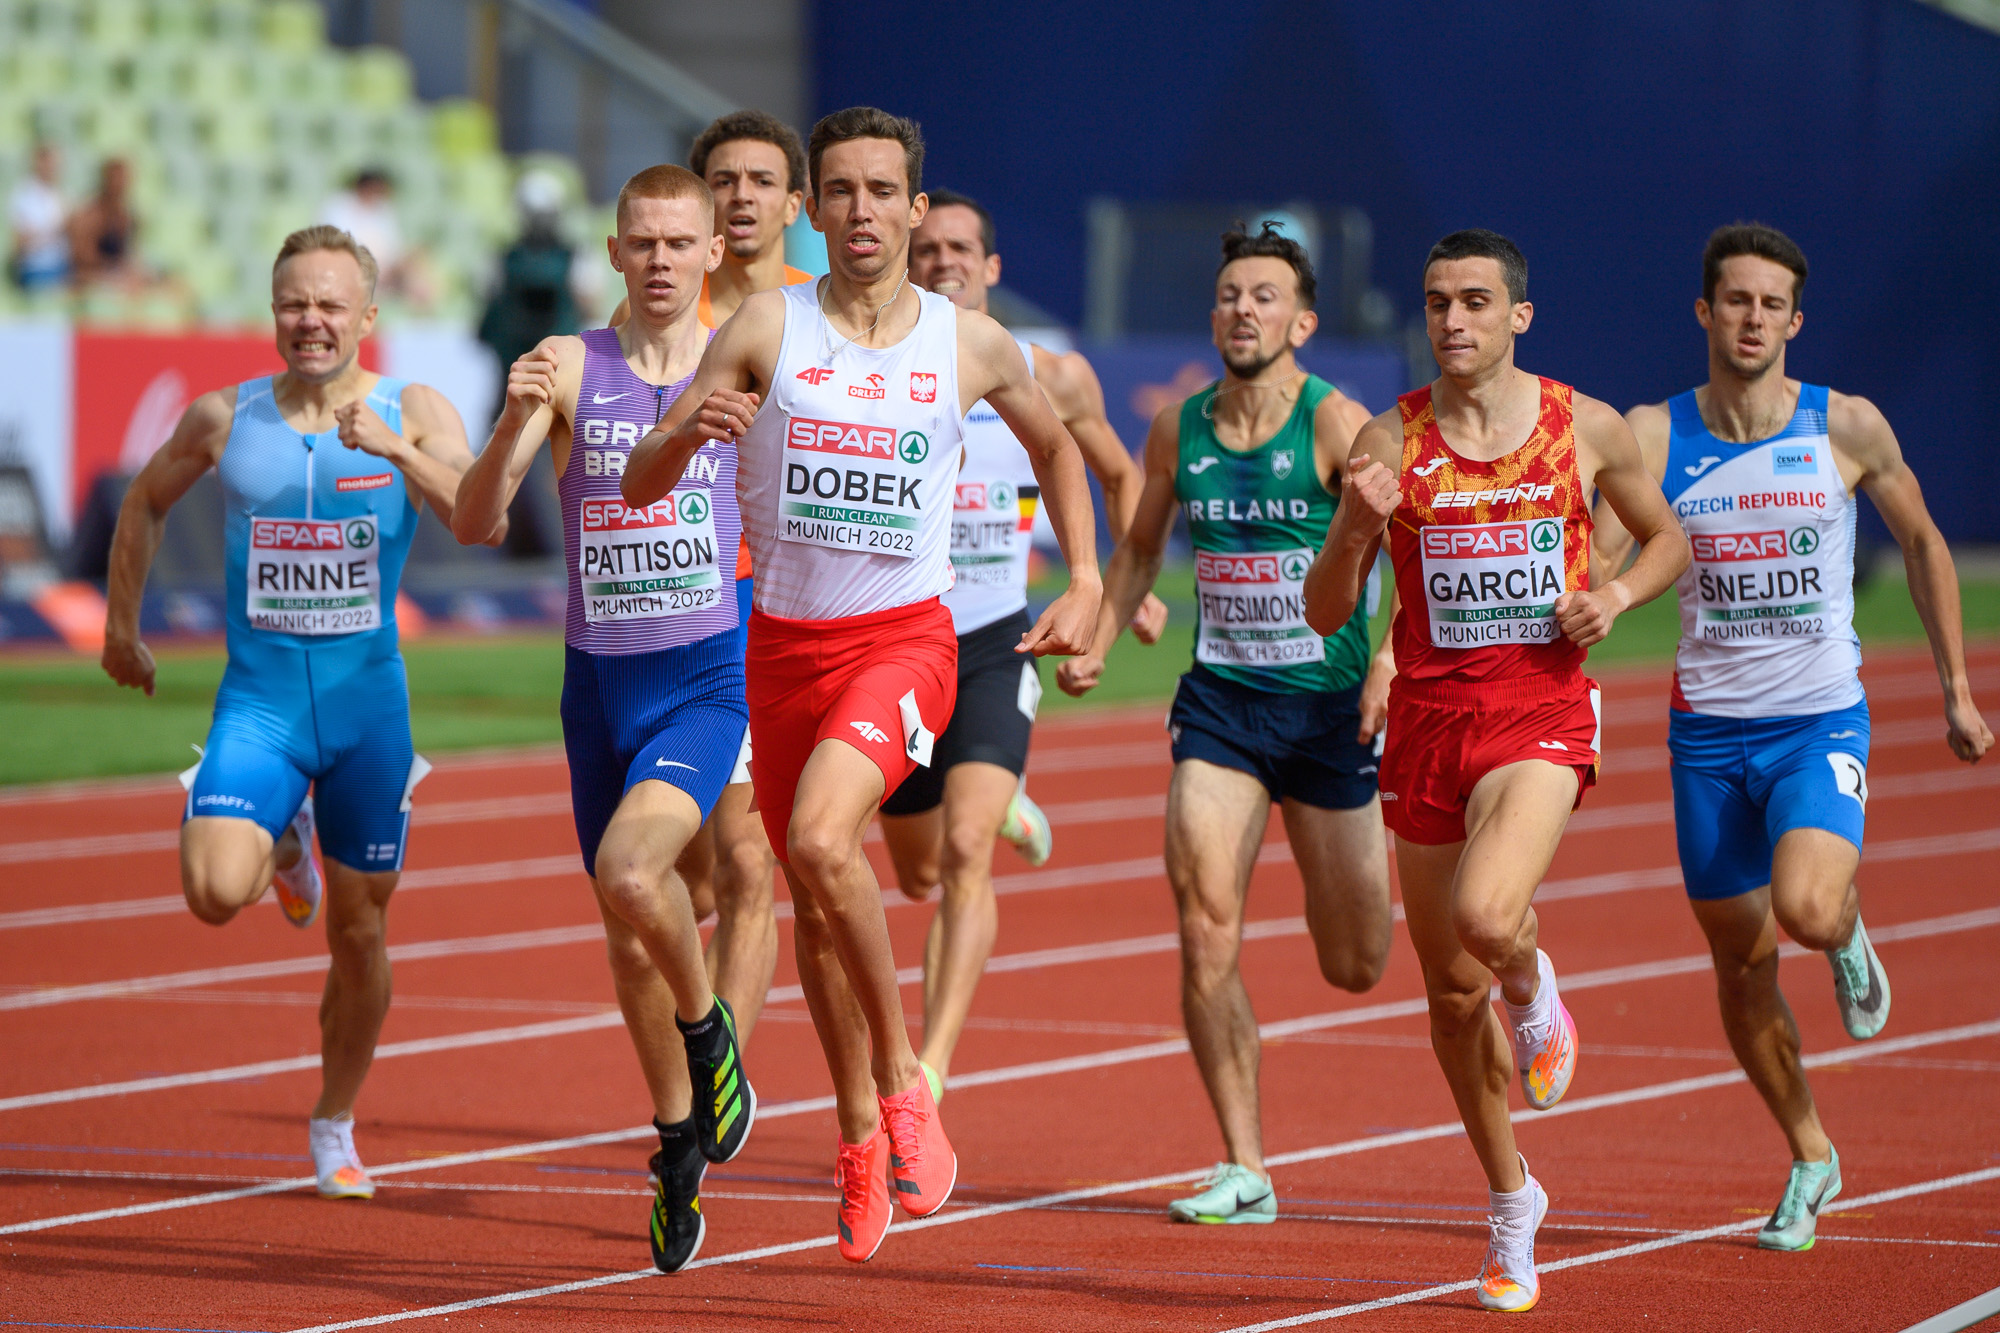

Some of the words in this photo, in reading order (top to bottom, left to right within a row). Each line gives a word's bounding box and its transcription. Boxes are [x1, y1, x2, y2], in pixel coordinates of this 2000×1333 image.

[796, 367, 835, 386] 4F
[850, 387, 884, 399] ORLEN
[791, 422, 893, 455] SPAR
[584, 451, 720, 484] BRIN
[339, 475, 392, 490] motonet
[786, 463, 922, 510] DOBEK
[1431, 483, 1555, 509] ESPAÑA
[1678, 496, 1734, 518] CZECH
[1739, 492, 1826, 510] REPUBLIC
[585, 500, 673, 527] SPAR
[819, 507, 845, 520] RUN
[255, 524, 342, 547] SPAR
[788, 520, 861, 544] MUNICH
[869, 531, 913, 551] 2022
[1426, 529, 1526, 555] SPAR
[1695, 535, 1785, 559] SPAR
[585, 537, 713, 576] PATTISON
[258, 560, 368, 590] RINNE
[1198, 558, 1278, 581] SPAR
[1429, 560, 1561, 602] GARCÍA
[618, 583, 642, 593] RUN
[1700, 567, 1823, 602] ŠNEJDR
[283, 600, 307, 609] RUN
[593, 596, 663, 616] MUNICH
[670, 589, 715, 609] 2022
[256, 612, 325, 629] MUNICH
[332, 609, 373, 627] 2022
[1466, 610, 1492, 621] RUN
[1731, 609, 1754, 620] RUN
[1439, 624, 1510, 642] MUNICH
[1704, 623, 1774, 640] MUNICH
[1780, 618, 1824, 636] 2022
[1206, 642, 1267, 660] MUNICH
[1272, 641, 1315, 660] 2022
[849, 721, 890, 745] 4F
[197, 795, 245, 808] CRAFT
